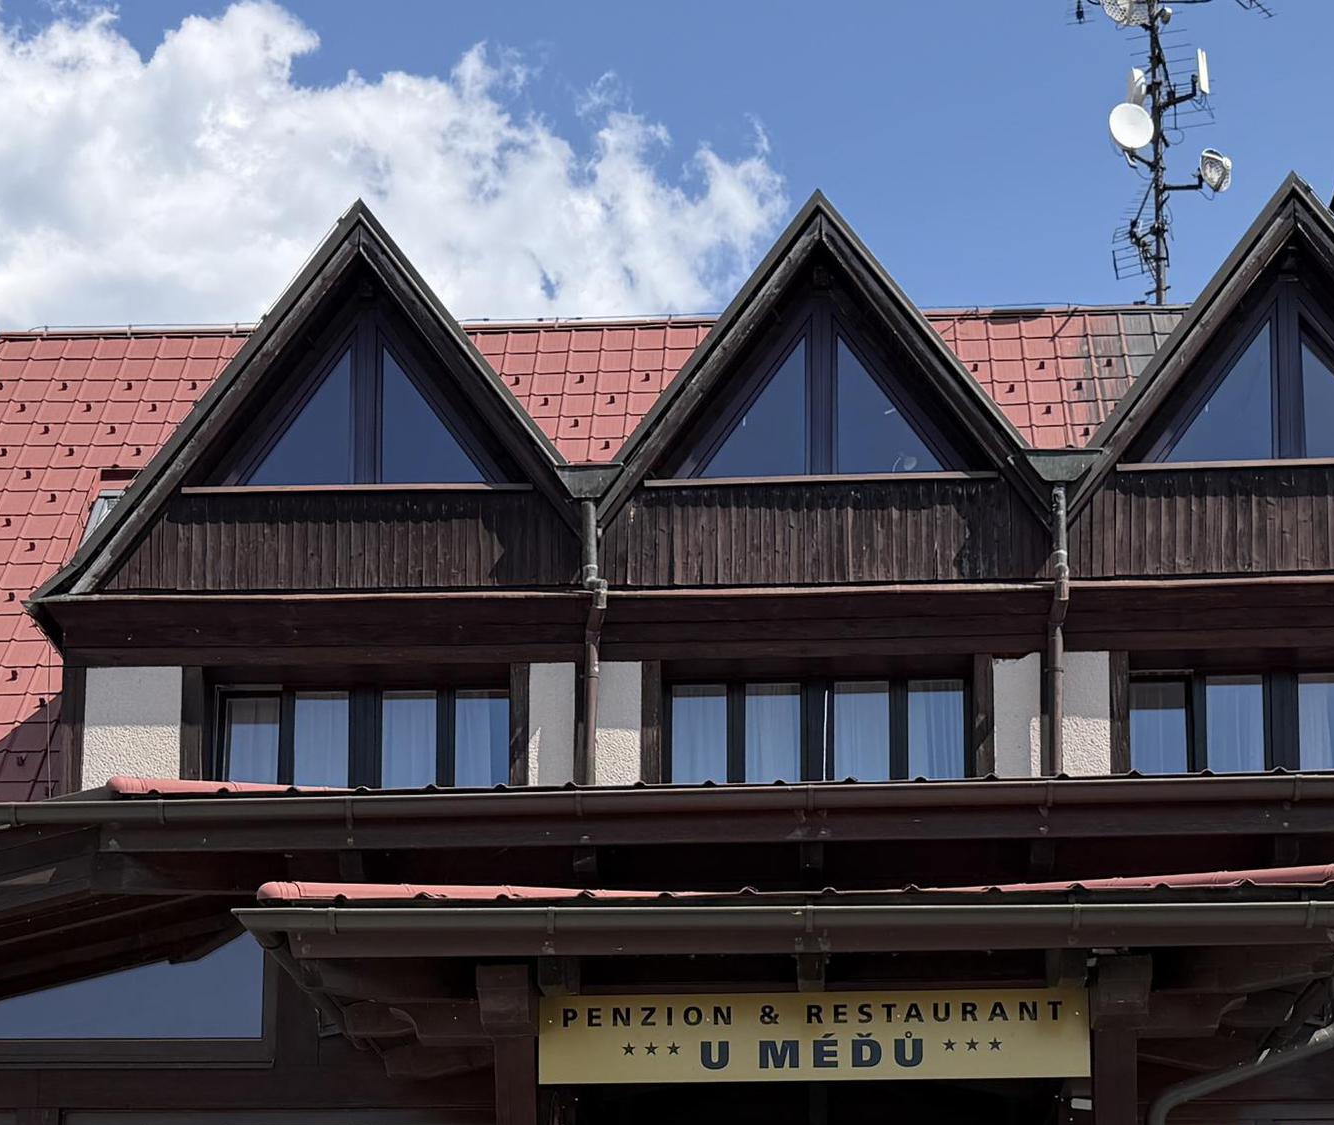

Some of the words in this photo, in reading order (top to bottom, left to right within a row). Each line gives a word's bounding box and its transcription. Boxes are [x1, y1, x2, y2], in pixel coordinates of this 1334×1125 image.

[561, 1004, 734, 1028] PENZION
[760, 1004, 781, 1026] &
[806, 1000, 1065, 1025] RESTAURANT
[700, 1040, 730, 1070] U
[758, 1030, 925, 1070] MÉĎŮ
